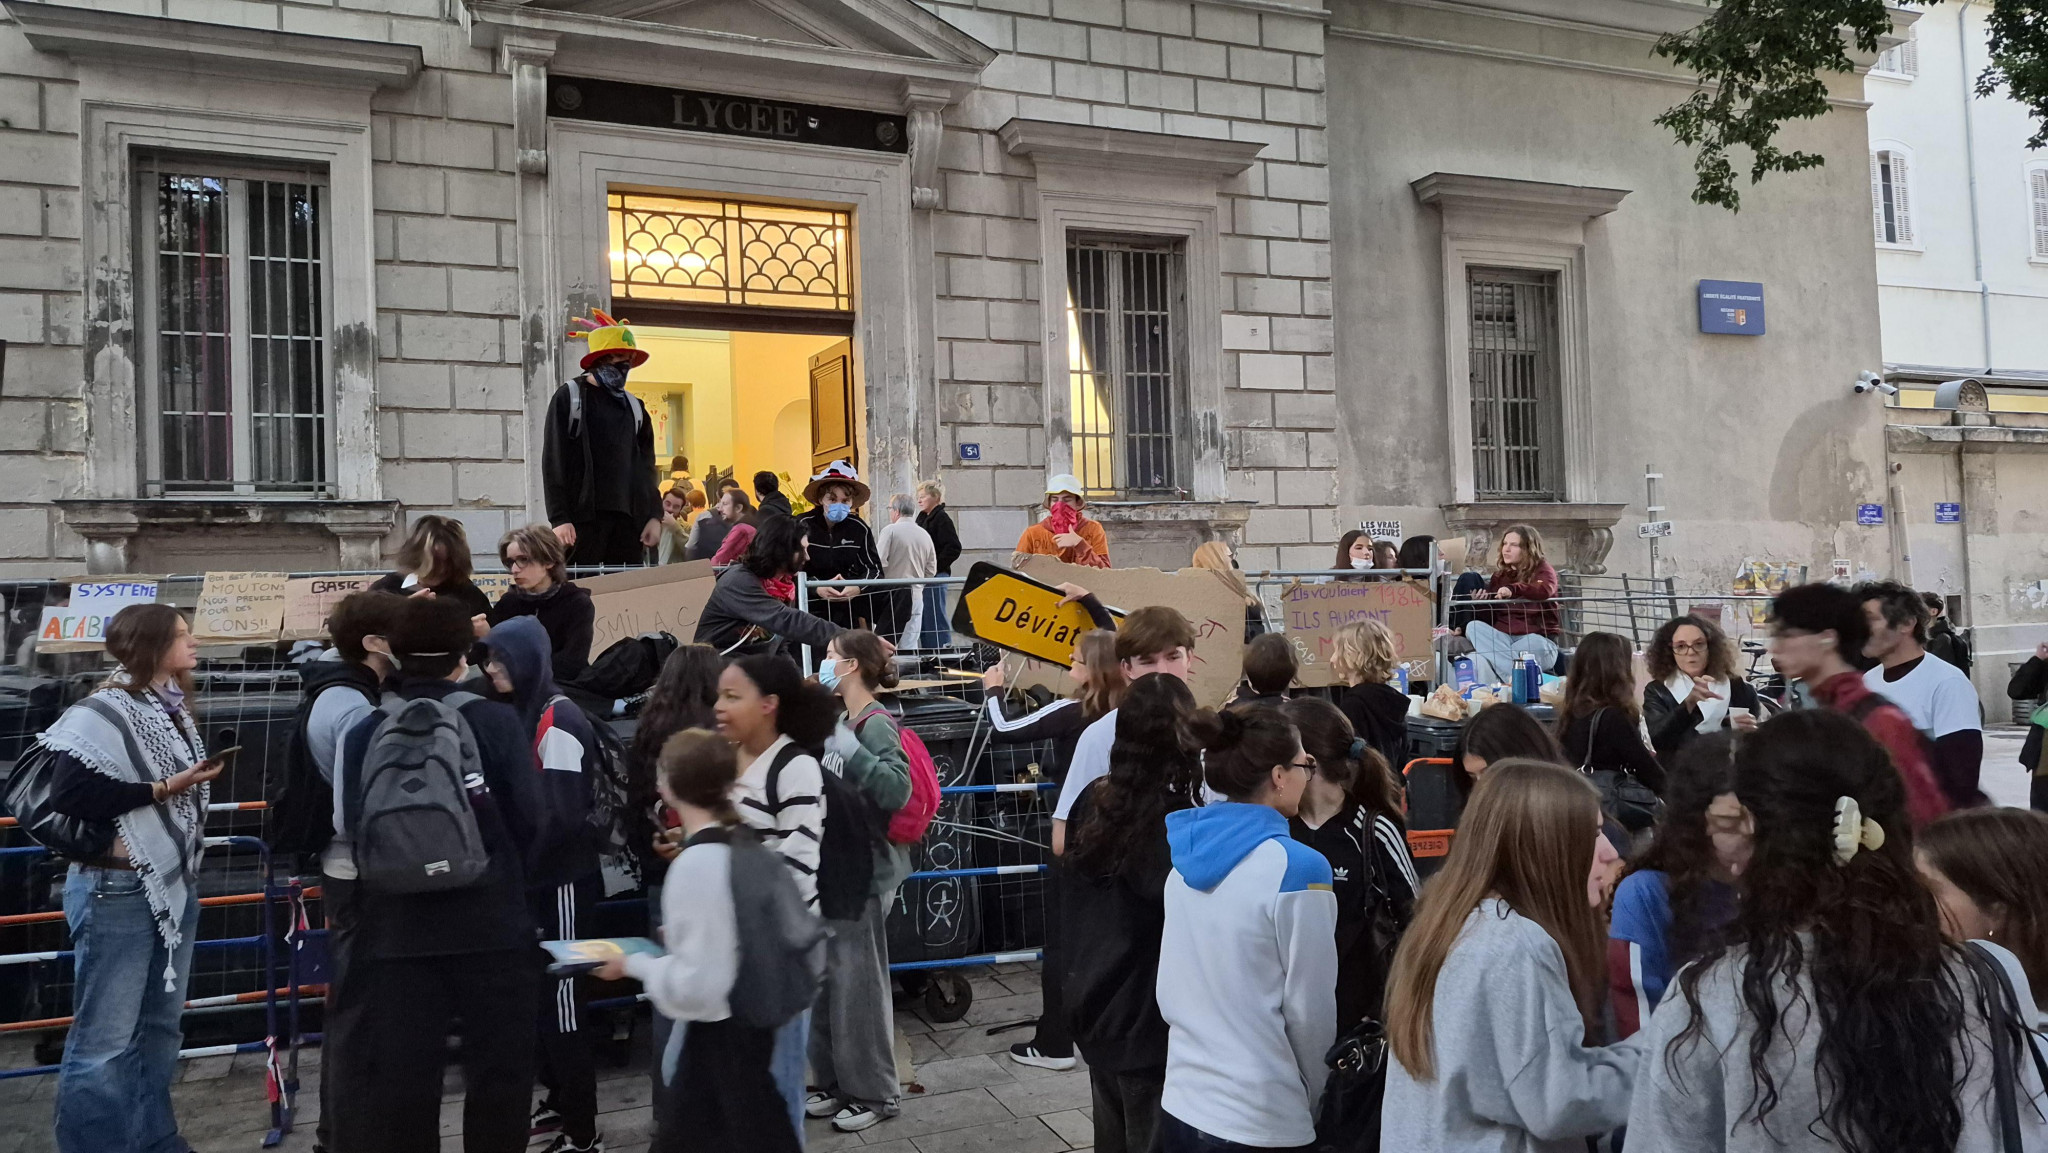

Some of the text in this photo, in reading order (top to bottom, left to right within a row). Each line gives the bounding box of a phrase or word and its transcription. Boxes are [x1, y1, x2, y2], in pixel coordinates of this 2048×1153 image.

[673, 95, 799, 137] LYCÉE
[1360, 521, 1400, 529] LES VRAIS
[1362, 529, 1400, 537] ASSEURS
[78, 583, 157, 597] SYSTEME
[212, 583, 285, 595] MOUTONS
[311, 580, 360, 594] BASIC
[203, 597, 228, 606] NOUS
[1375, 584, 1424, 607] 1984
[200, 607, 229, 616] POUR
[208, 618, 268, 632] CONS!!
[995, 597, 1081, 647] Déviat
[1292, 610, 1320, 630] ILS
